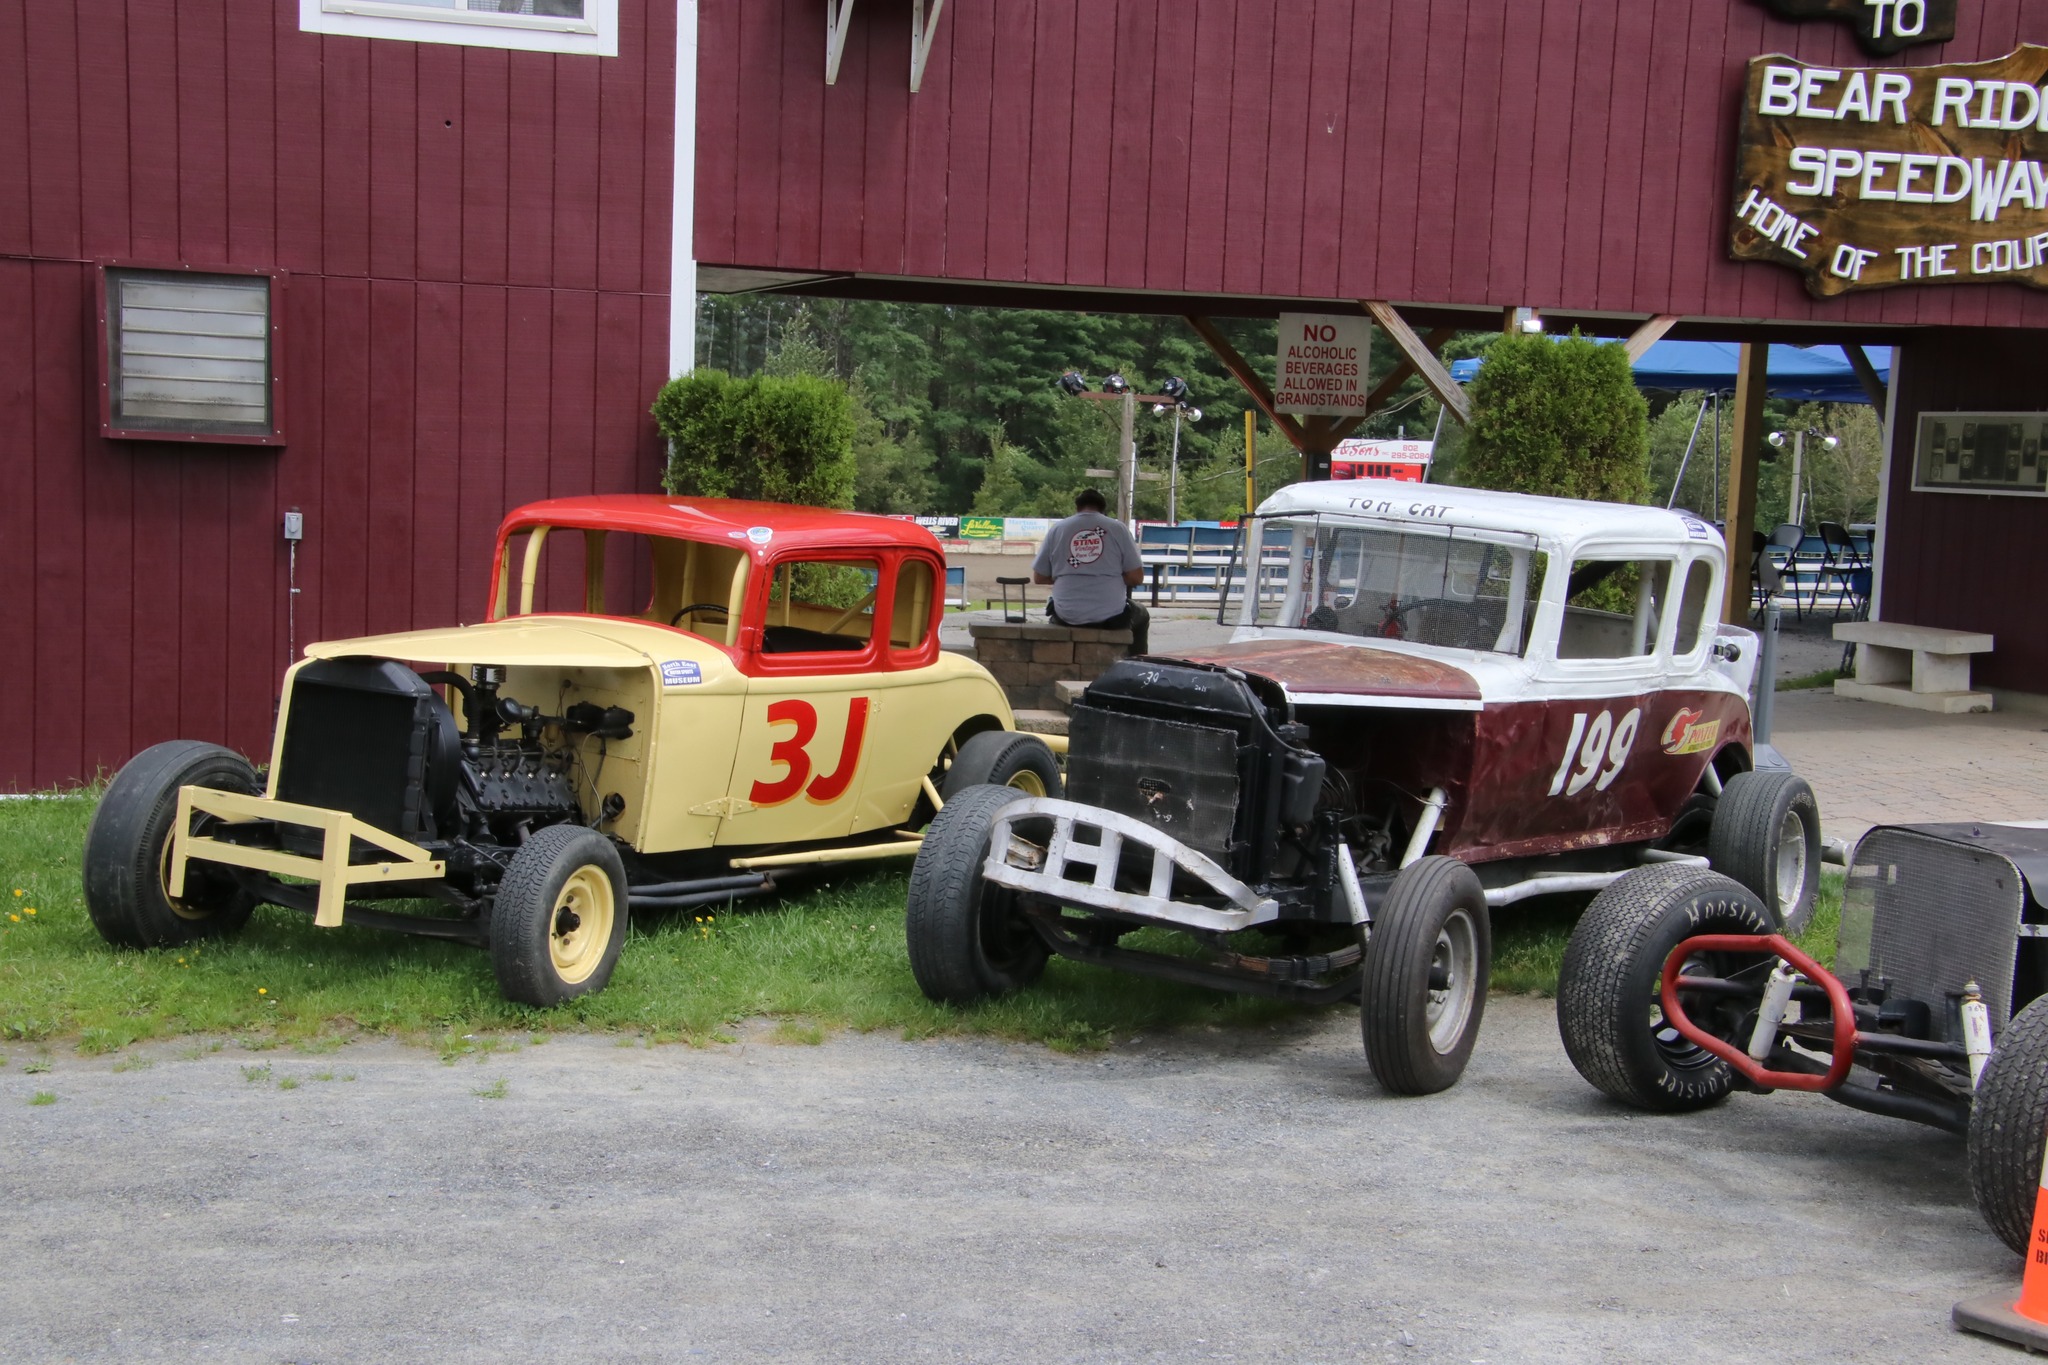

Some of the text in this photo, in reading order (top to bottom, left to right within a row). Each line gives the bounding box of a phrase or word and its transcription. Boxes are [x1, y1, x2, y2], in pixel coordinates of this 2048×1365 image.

[1864, 0, 1926, 38] TO
[1759, 66, 1912, 124] BEAR
[1737, 189, 1820, 259] HOME
[1830, 244, 1879, 281] OF
[1895, 244, 1957, 280] THE
[1303, 324, 1337, 342] NO
[1288, 345, 1357, 360] ALCOHOLIC
[1285, 361, 1358, 376] BEVERAGES
[1283, 377, 1357, 391] ALLOWED IN
[1275, 391, 1365, 407] GRANDSTANDS
[1349, 497, 1454, 518] TOM CAT
[915, 516, 938, 526] WELLS
[937, 517, 959, 527] RIVER
[664, 677, 701, 685] MUSEUM
[749, 697, 870, 808] 3J
[1547, 707, 1641, 797] 199
